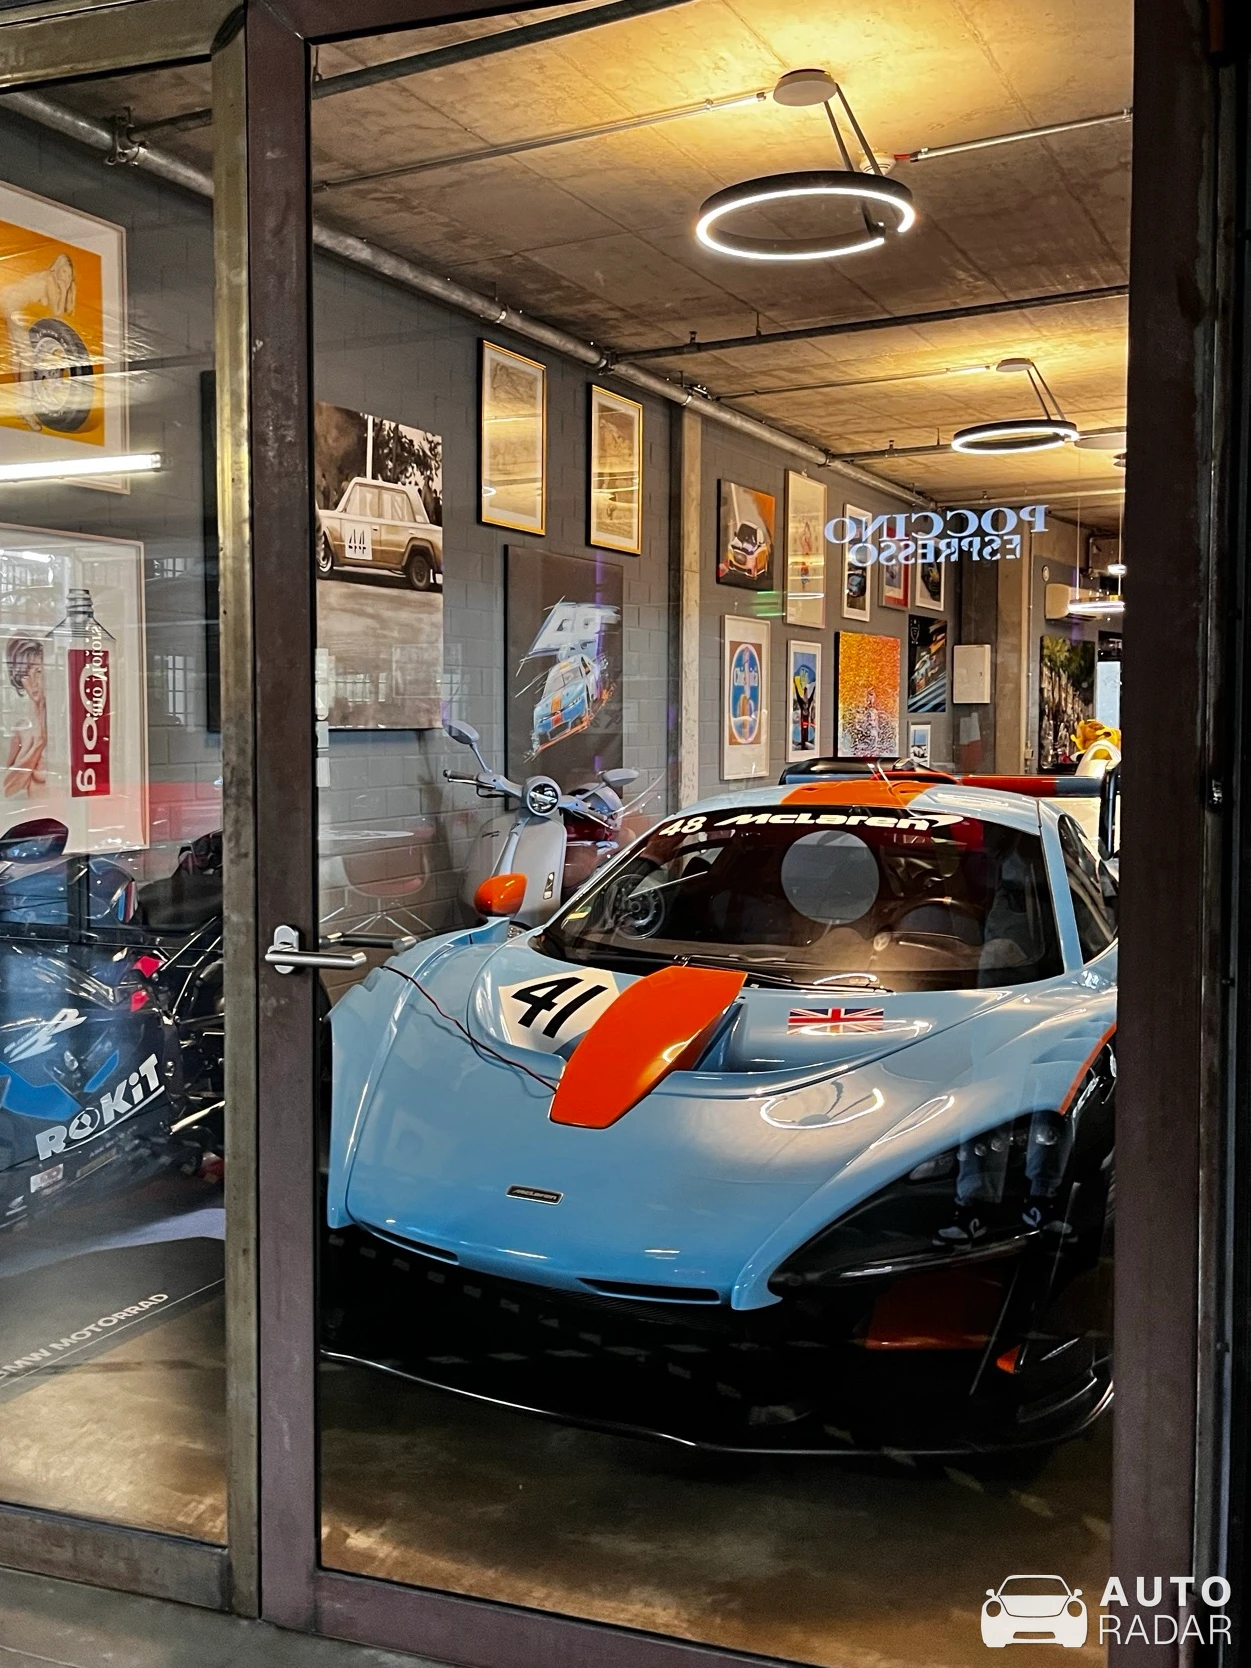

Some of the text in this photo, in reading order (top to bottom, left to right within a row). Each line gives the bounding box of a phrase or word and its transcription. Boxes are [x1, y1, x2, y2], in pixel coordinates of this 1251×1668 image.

[348, 528, 367, 555] 44
[659, 812, 930, 837] 48 McLaren
[511, 976, 609, 1039] 41
[0, 1293, 169, 1380] MW MOTORRAD
